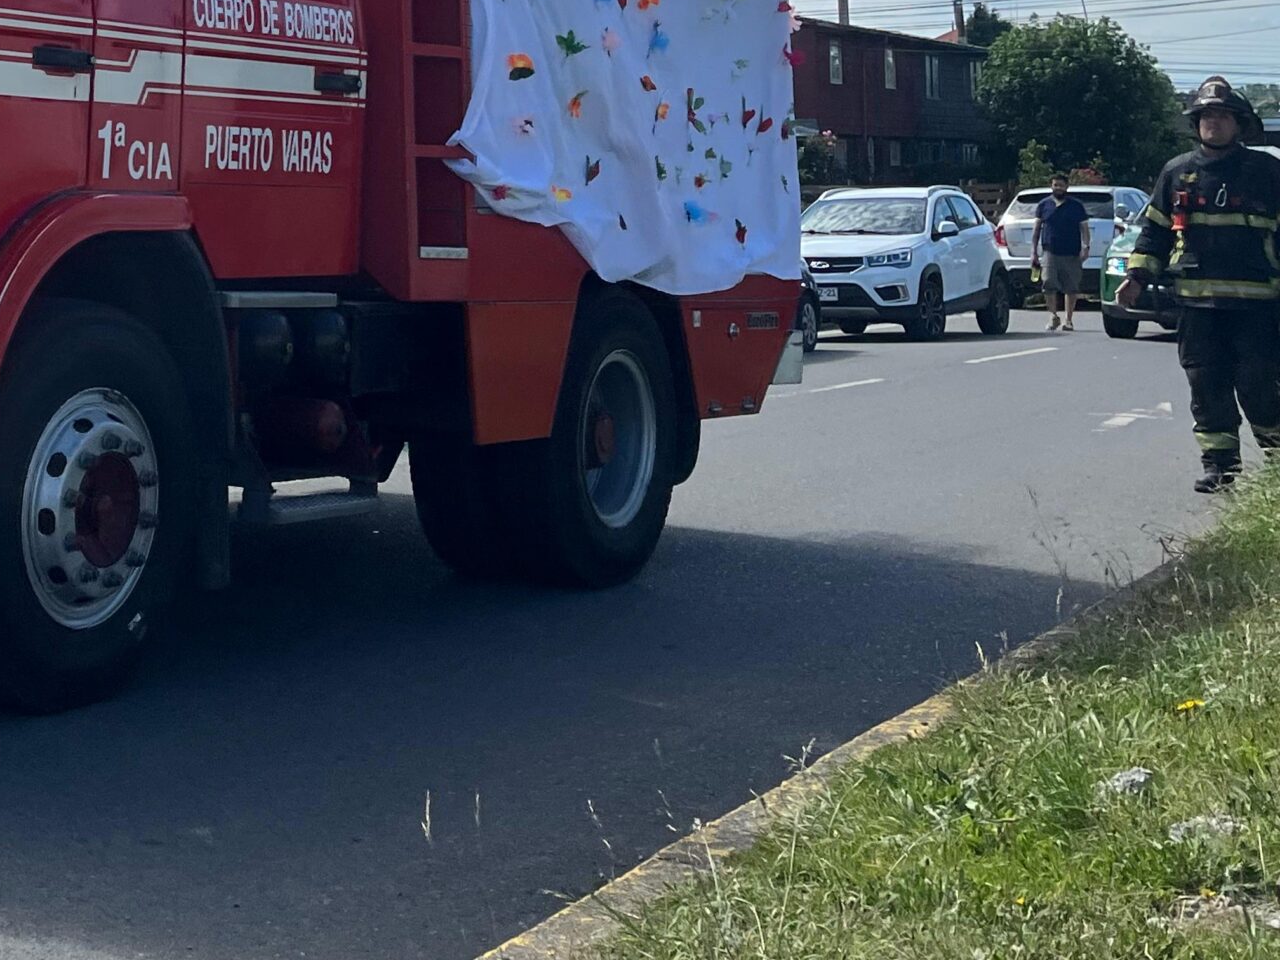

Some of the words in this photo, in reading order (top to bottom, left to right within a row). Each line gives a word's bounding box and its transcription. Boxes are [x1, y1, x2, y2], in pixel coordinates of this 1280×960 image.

[284, 2, 354, 44] BOMBEROS
[128, 140, 172, 180] CIA
[205, 125, 274, 172] PUERTO
[282, 129, 333, 174] VARAS
